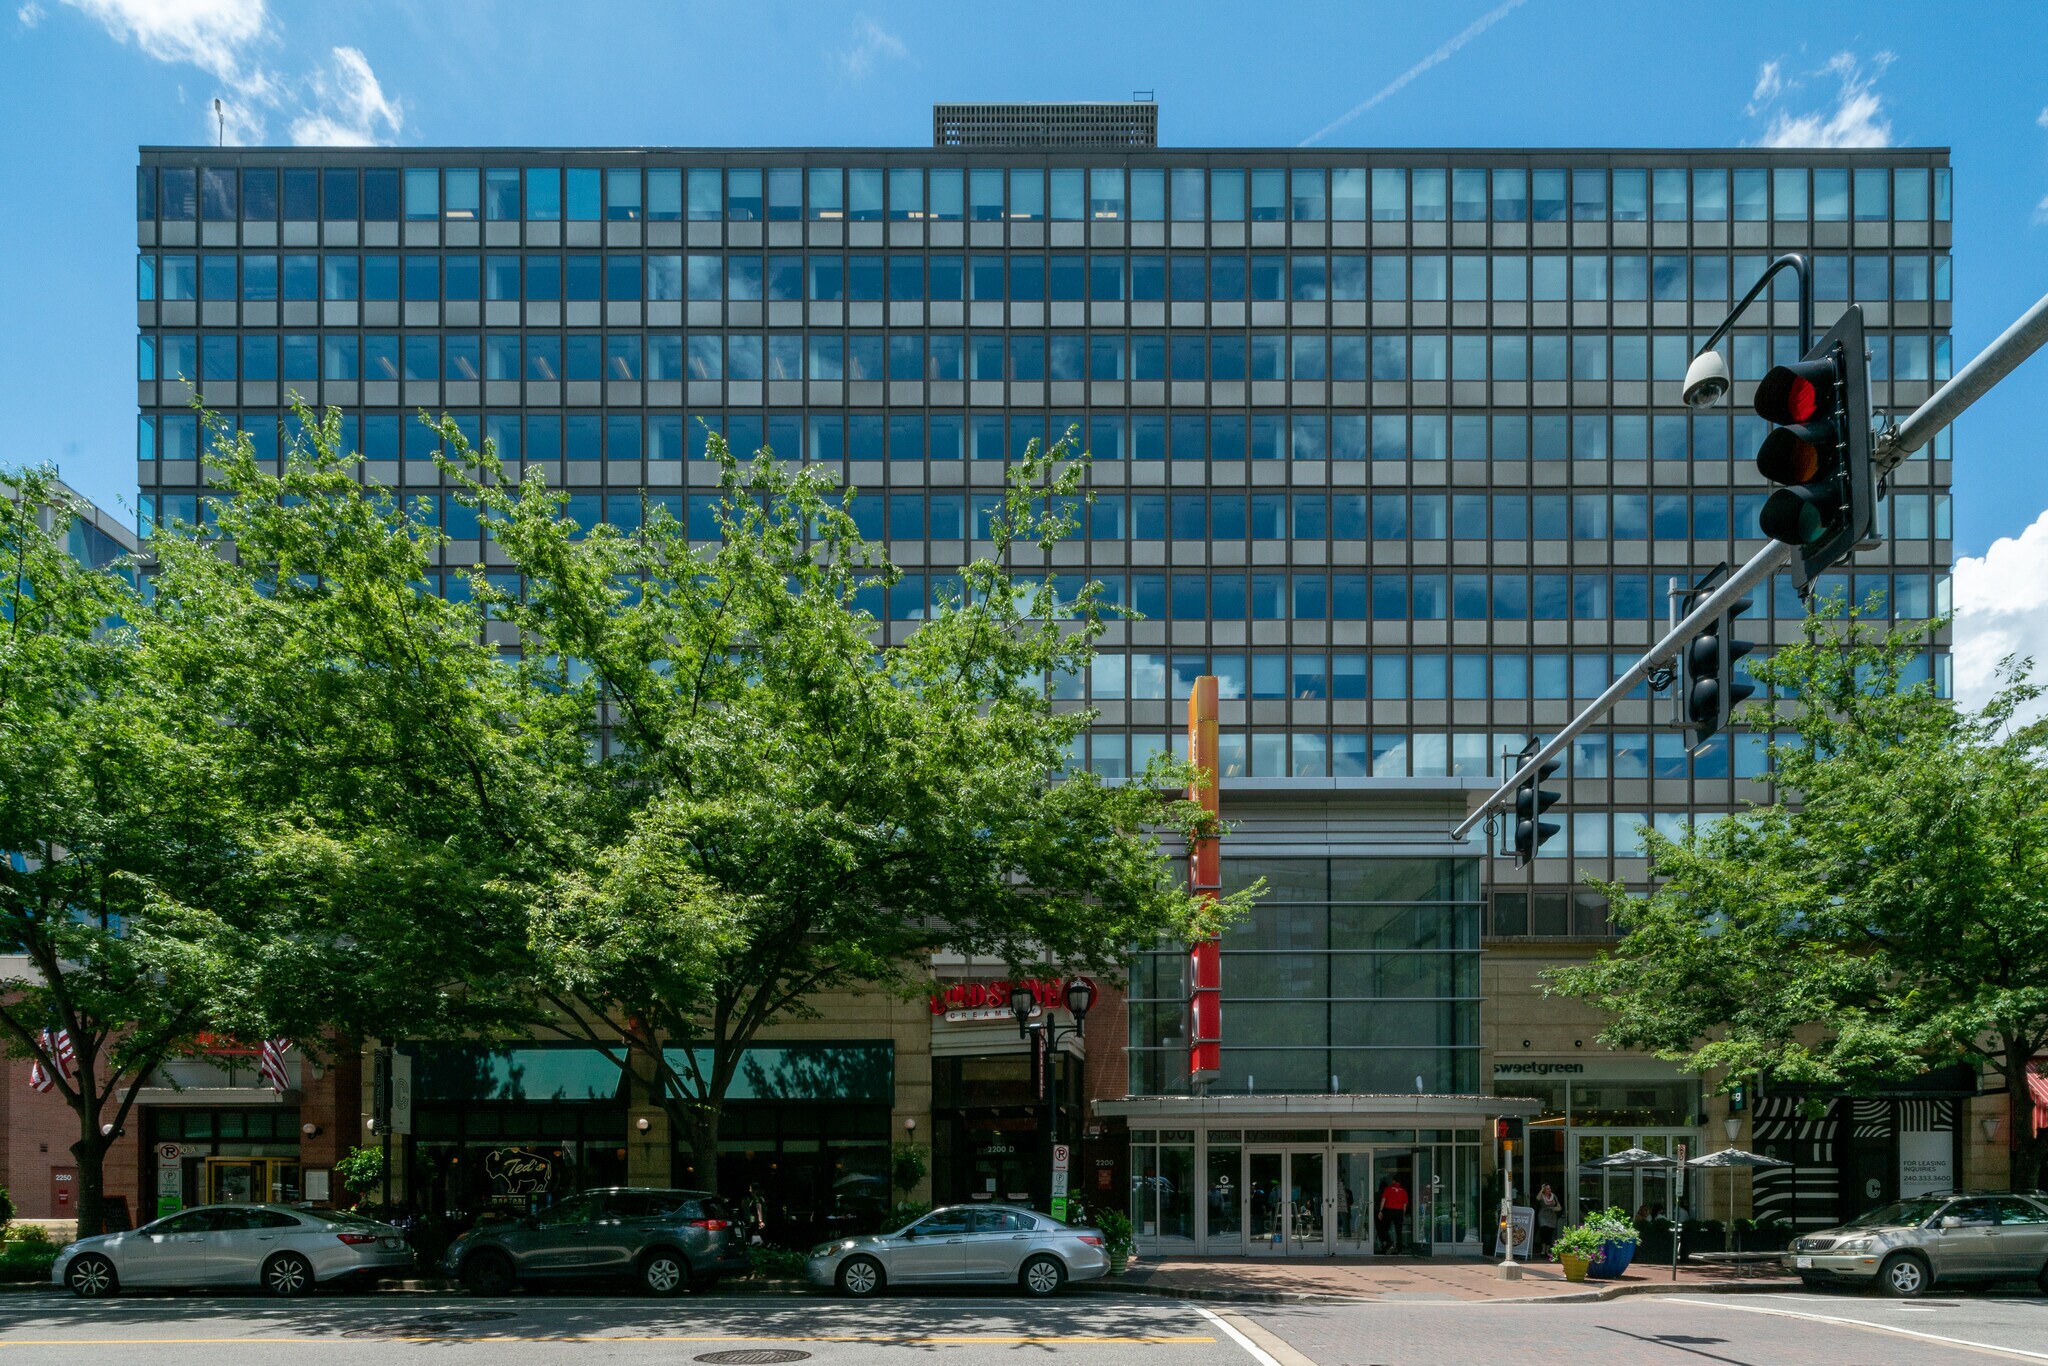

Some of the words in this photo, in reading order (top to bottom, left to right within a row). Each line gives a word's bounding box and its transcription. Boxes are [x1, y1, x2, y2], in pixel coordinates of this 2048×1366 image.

[988, 977, 1061, 1008] STNE
[950, 1006, 1038, 1020] CREAMEY
[1494, 1061, 1584, 1075] sweetgreen
[987, 1145, 1007, 1153] 2200
[503, 1158, 545, 1177] Ted's
